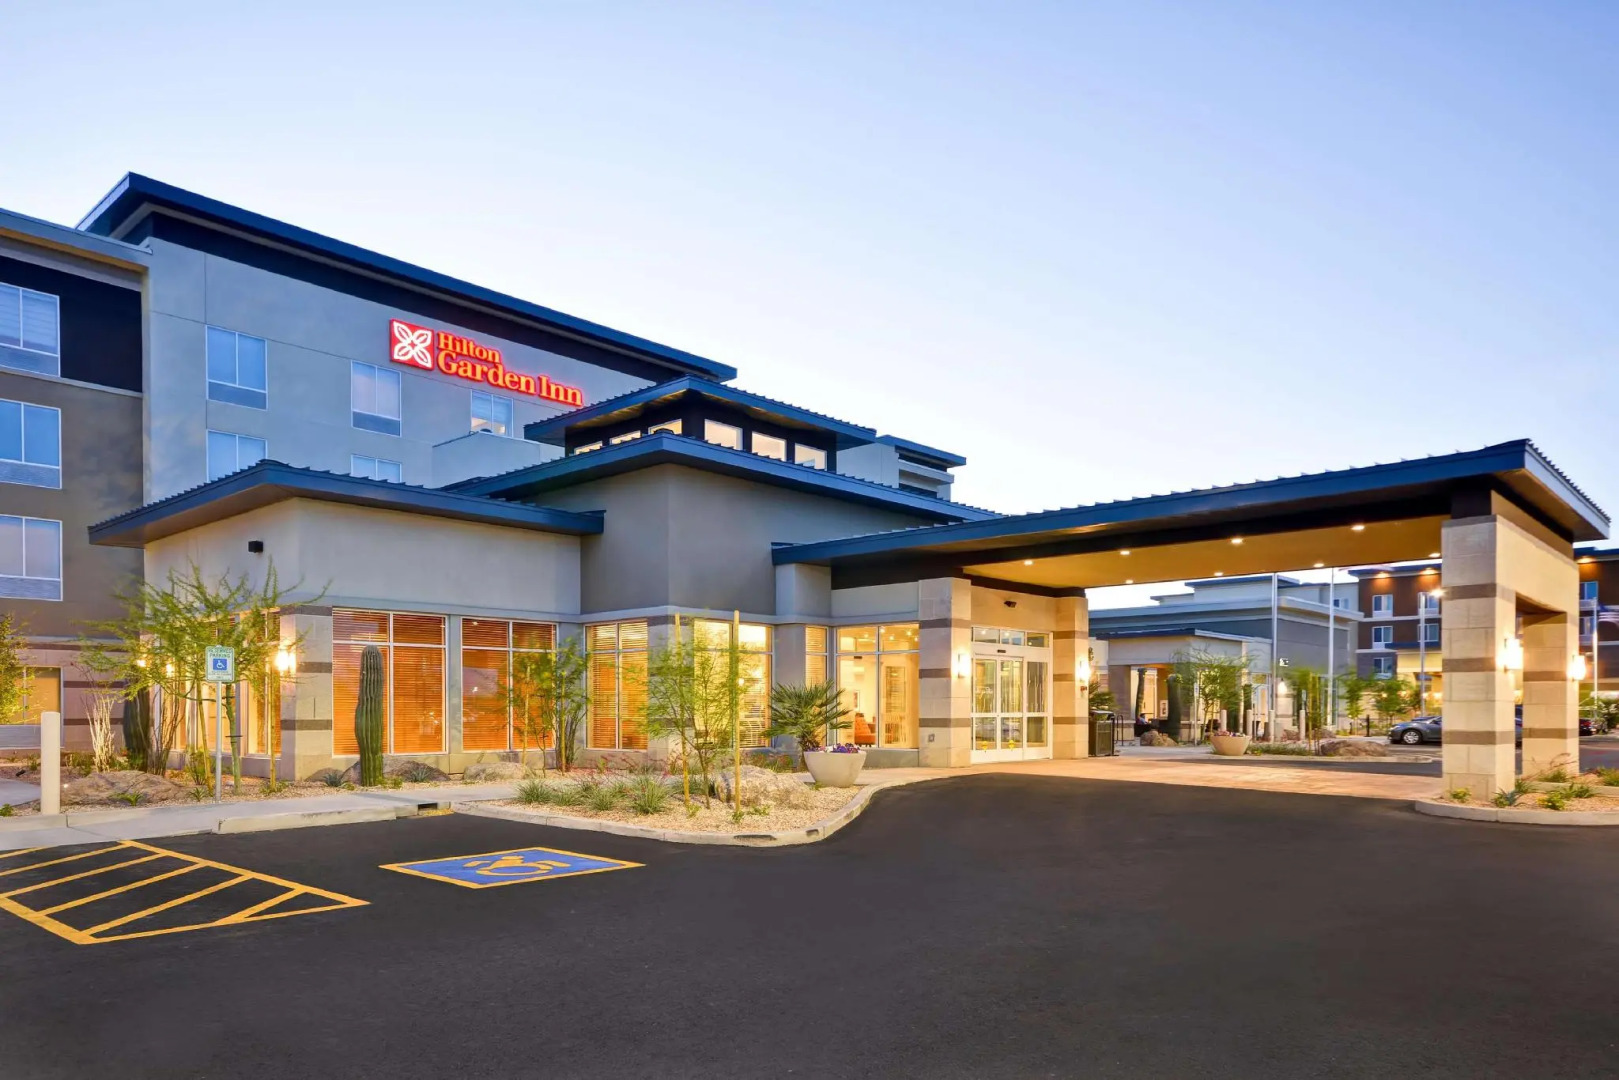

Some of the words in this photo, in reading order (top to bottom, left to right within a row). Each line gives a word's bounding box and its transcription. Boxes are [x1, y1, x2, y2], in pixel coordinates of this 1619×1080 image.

[437, 332, 501, 362] Hilton
[437, 351, 536, 395] Garden
[538, 375, 582, 407] Inn
